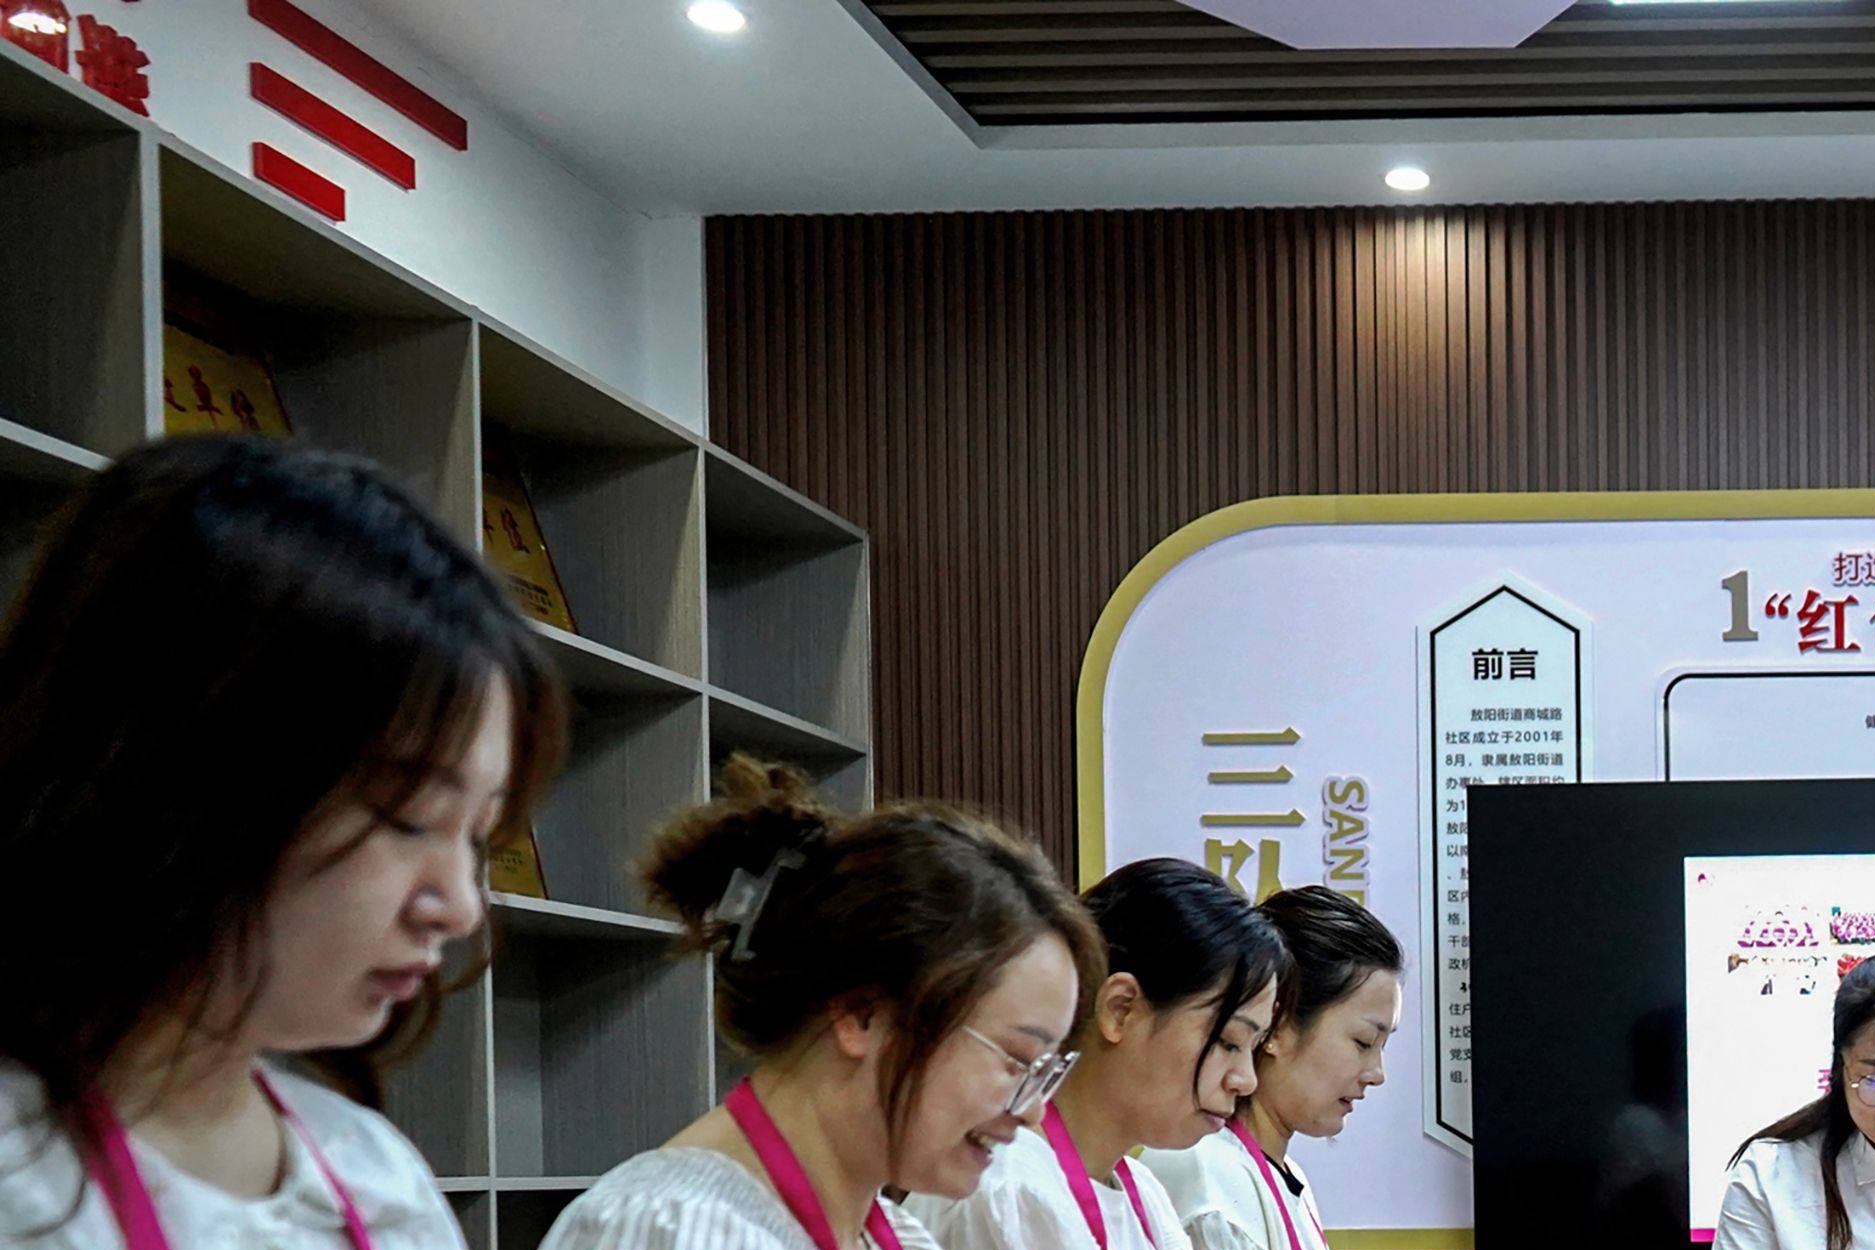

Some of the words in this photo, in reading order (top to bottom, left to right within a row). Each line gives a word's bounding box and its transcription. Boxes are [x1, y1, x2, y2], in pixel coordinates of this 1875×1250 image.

[1721, 570, 1759, 641] 1
[1472, 648, 1538, 680] 前言
[1445, 731, 1564, 744] 社区成立于2001年
